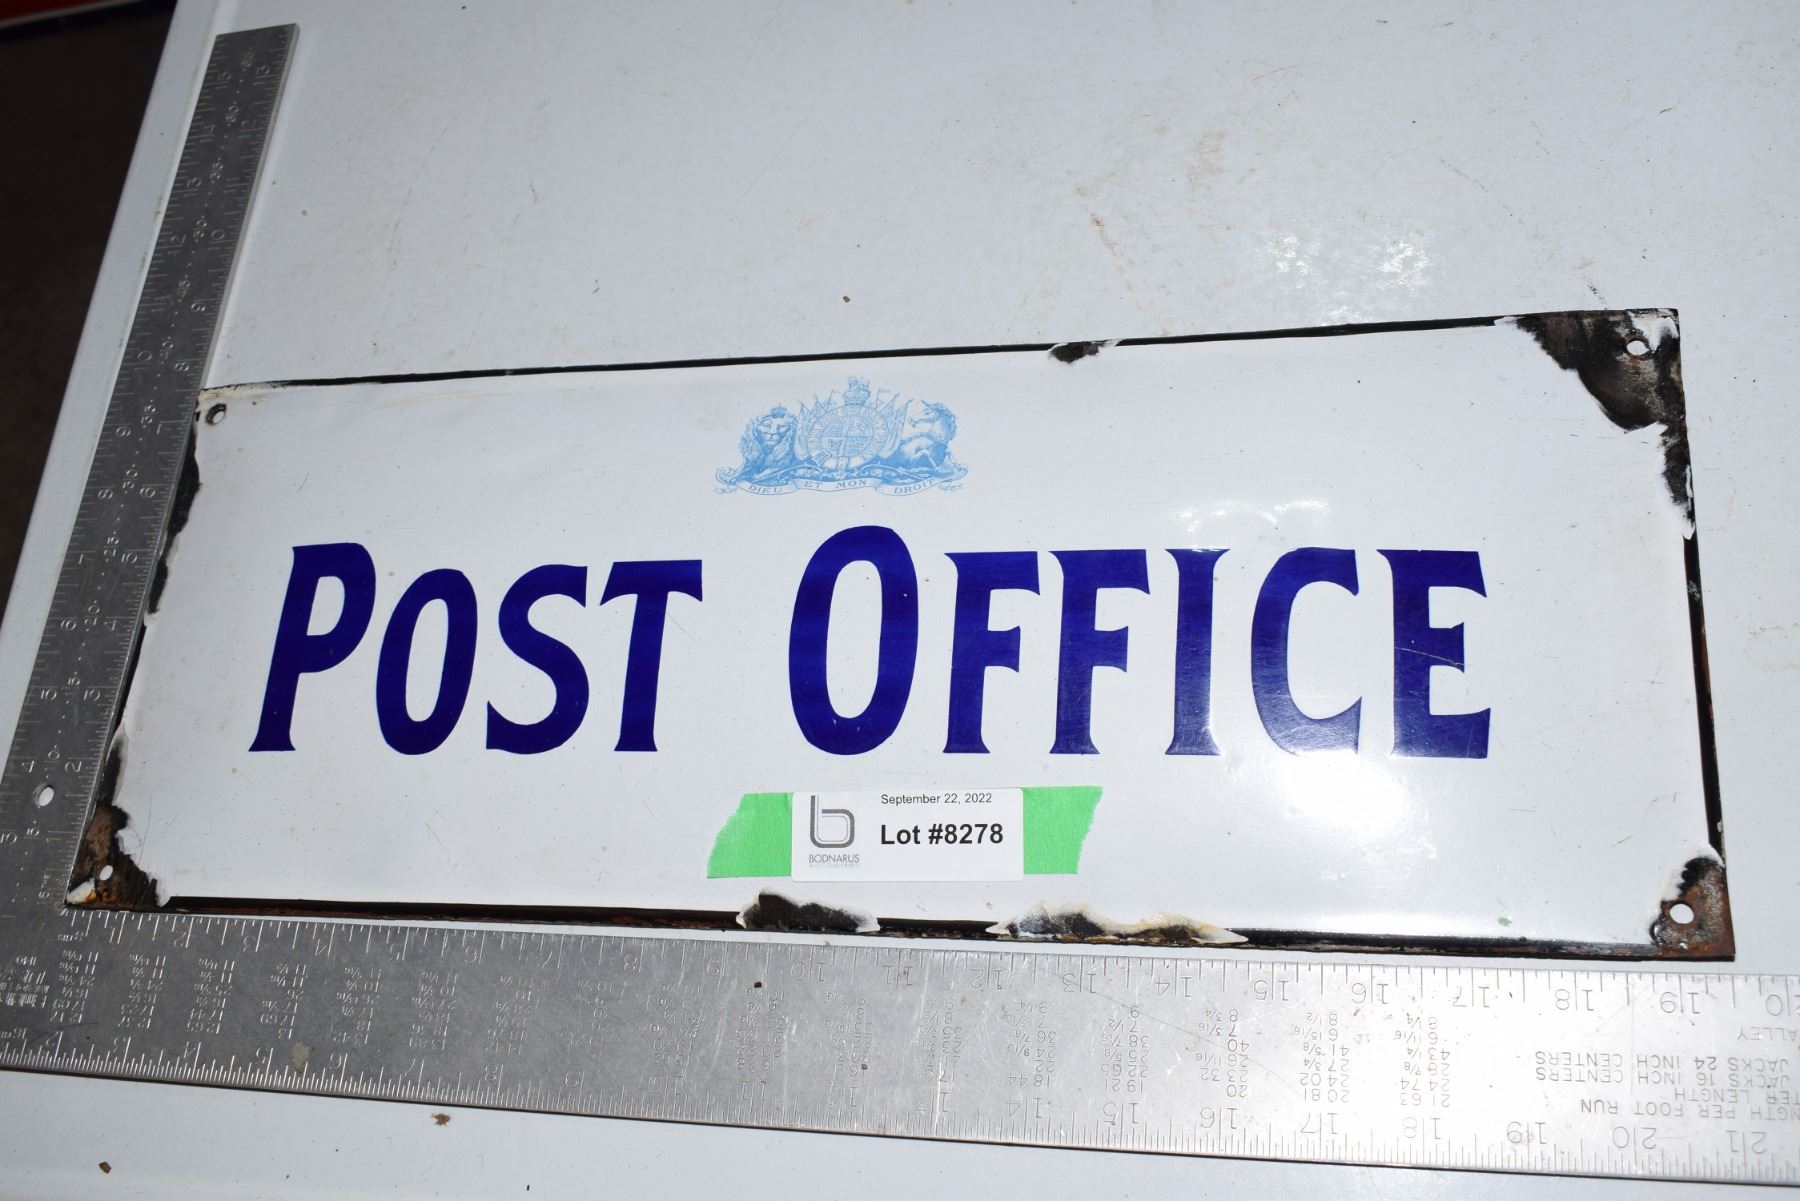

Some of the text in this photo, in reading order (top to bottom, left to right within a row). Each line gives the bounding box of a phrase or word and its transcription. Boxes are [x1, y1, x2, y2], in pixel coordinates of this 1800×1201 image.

[804, 481, 823, 490] ET
[836, 478, 867, 489] MON
[894, 478, 935, 494] DROIT
[249, 525, 1491, 758] POST OFFICE
[881, 793, 992, 806] September 22, 2022
[881, 823, 1004, 845] Lot #8278
[809, 854, 860, 863] BODNARUS
[1737, 1026, 1800, 1042] ALLEY
[1534, 1050, 1789, 1072] JACKS 24 INCH CENTERS
[1535, 1066, 1790, 1089] JACKS 16 INCH CENTERS
[1226, 1083, 1248, 1098] 20
[1674, 1087, 1750, 1104] LENGTH
[1579, 1099, 1618, 1115] RUN
[1632, 1100, 1684, 1117] FOOT
[1698, 1103, 1736, 1119] PER
